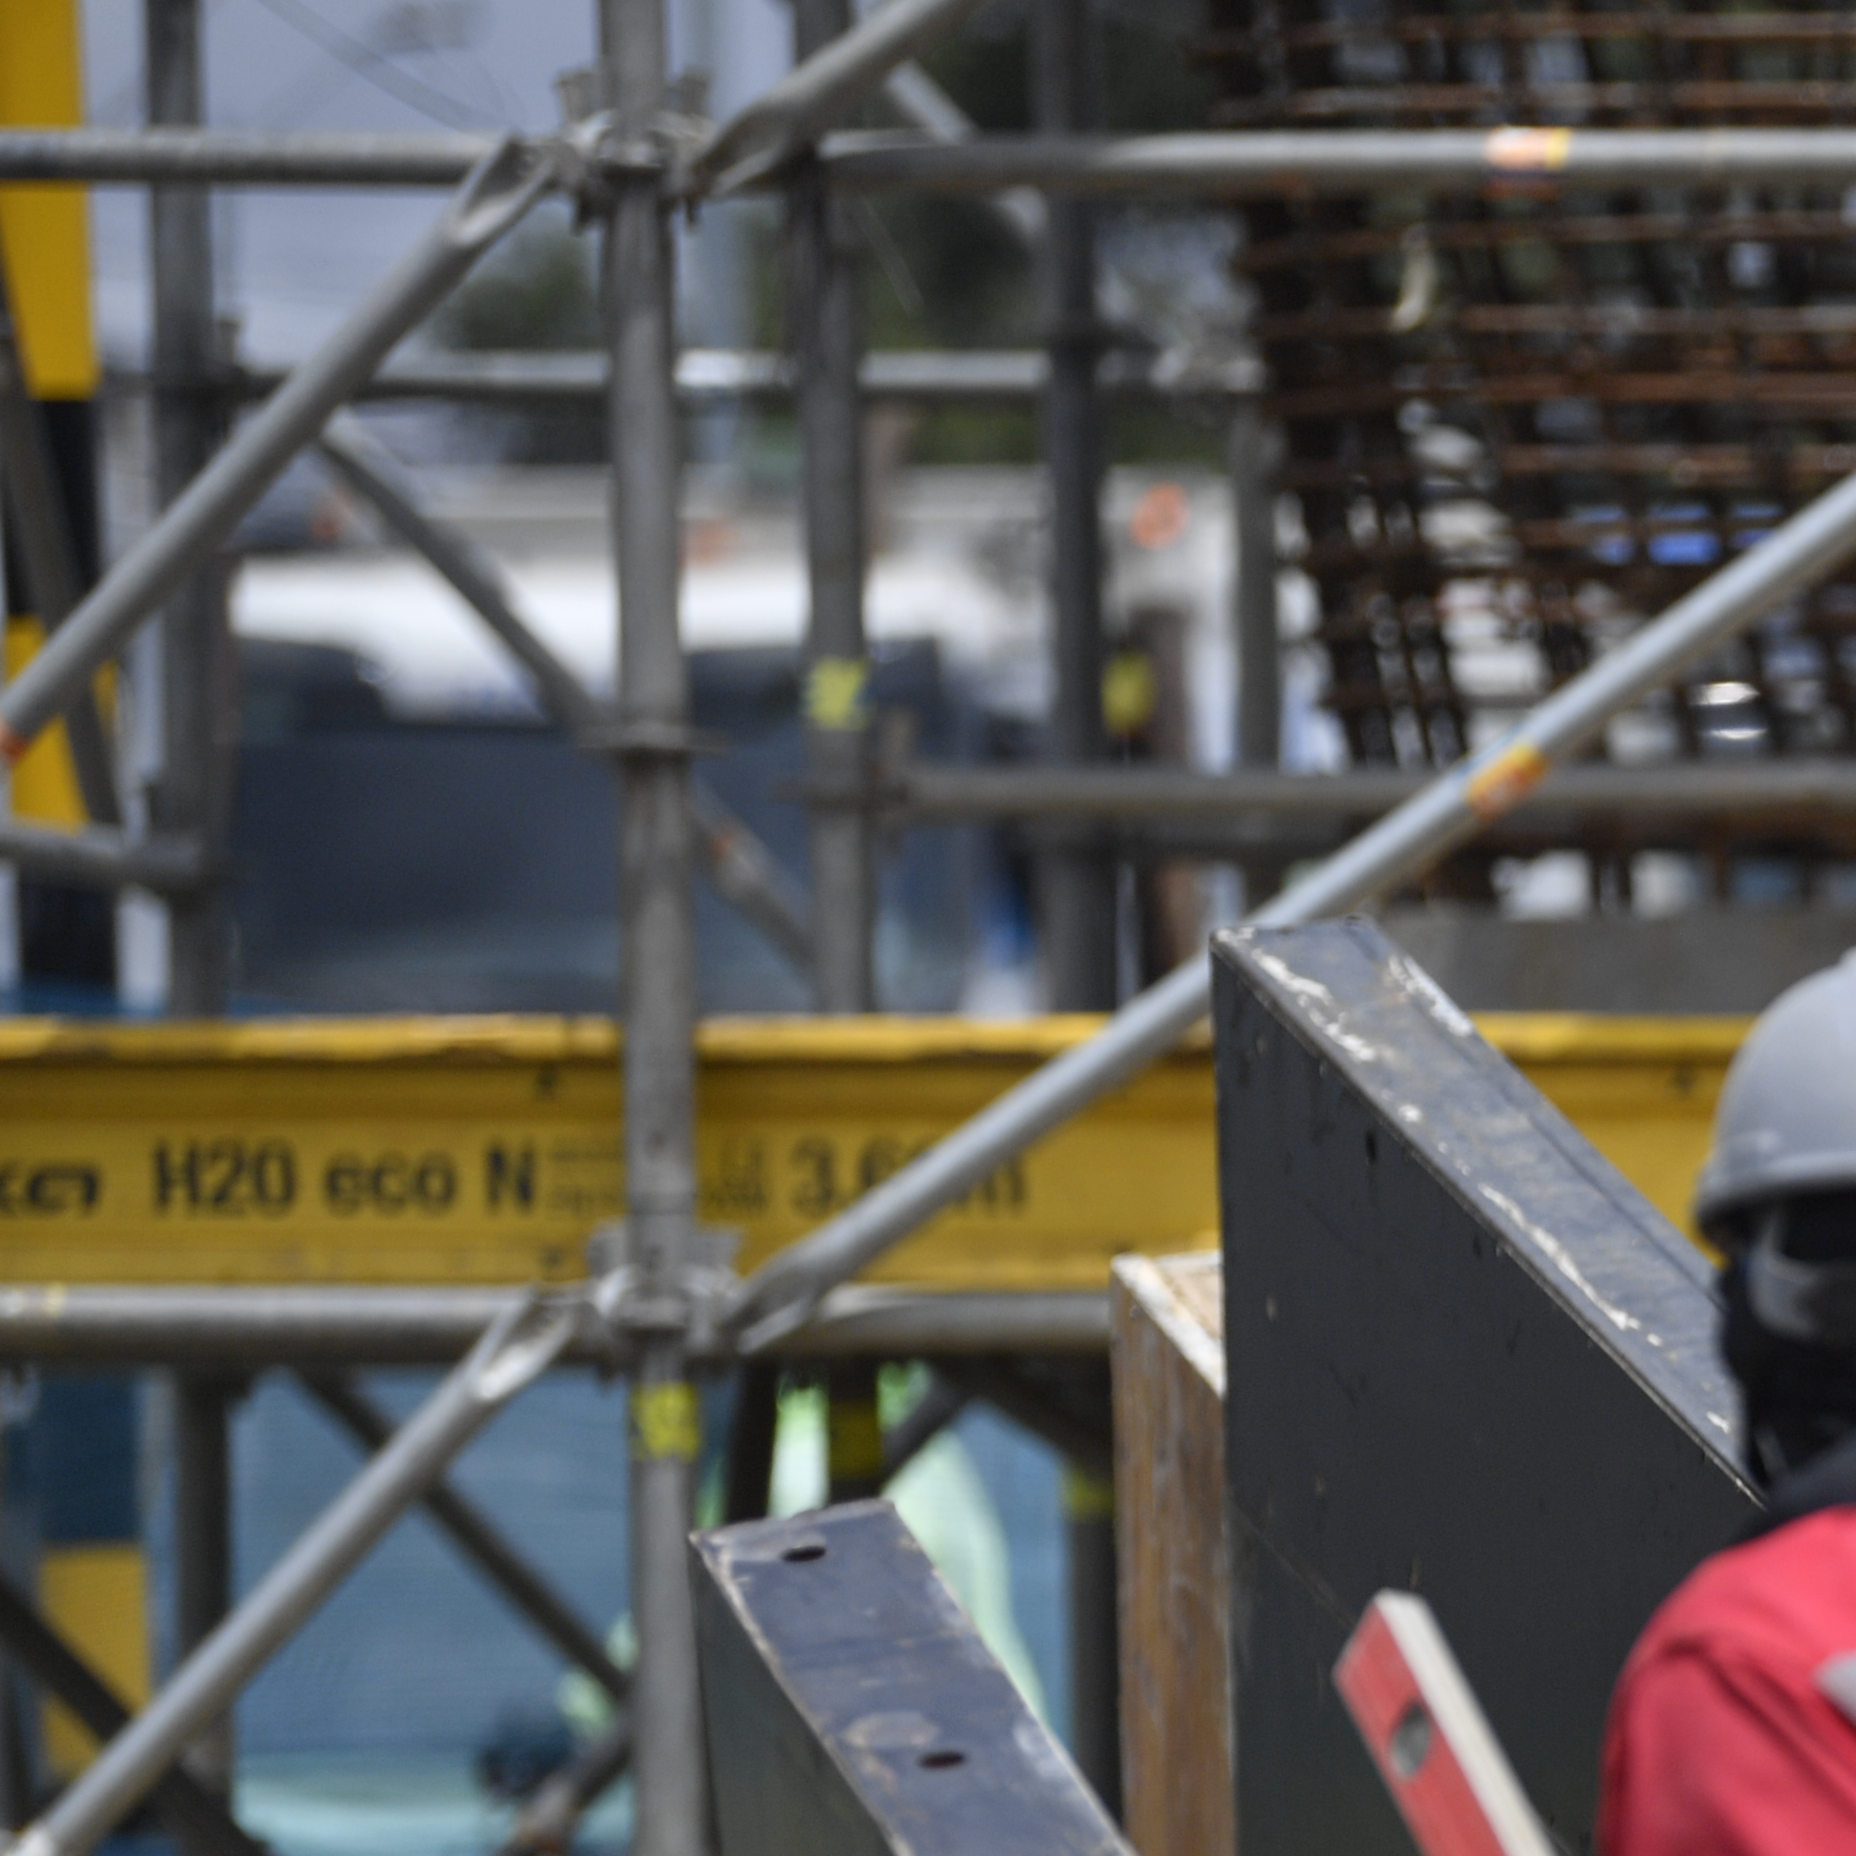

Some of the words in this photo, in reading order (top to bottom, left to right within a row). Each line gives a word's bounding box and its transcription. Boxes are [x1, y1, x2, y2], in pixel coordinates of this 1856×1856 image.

[150, 1137, 298, 1218] H20
[322, 1154, 460, 1218] eco
[484, 1141, 536, 1216] N
